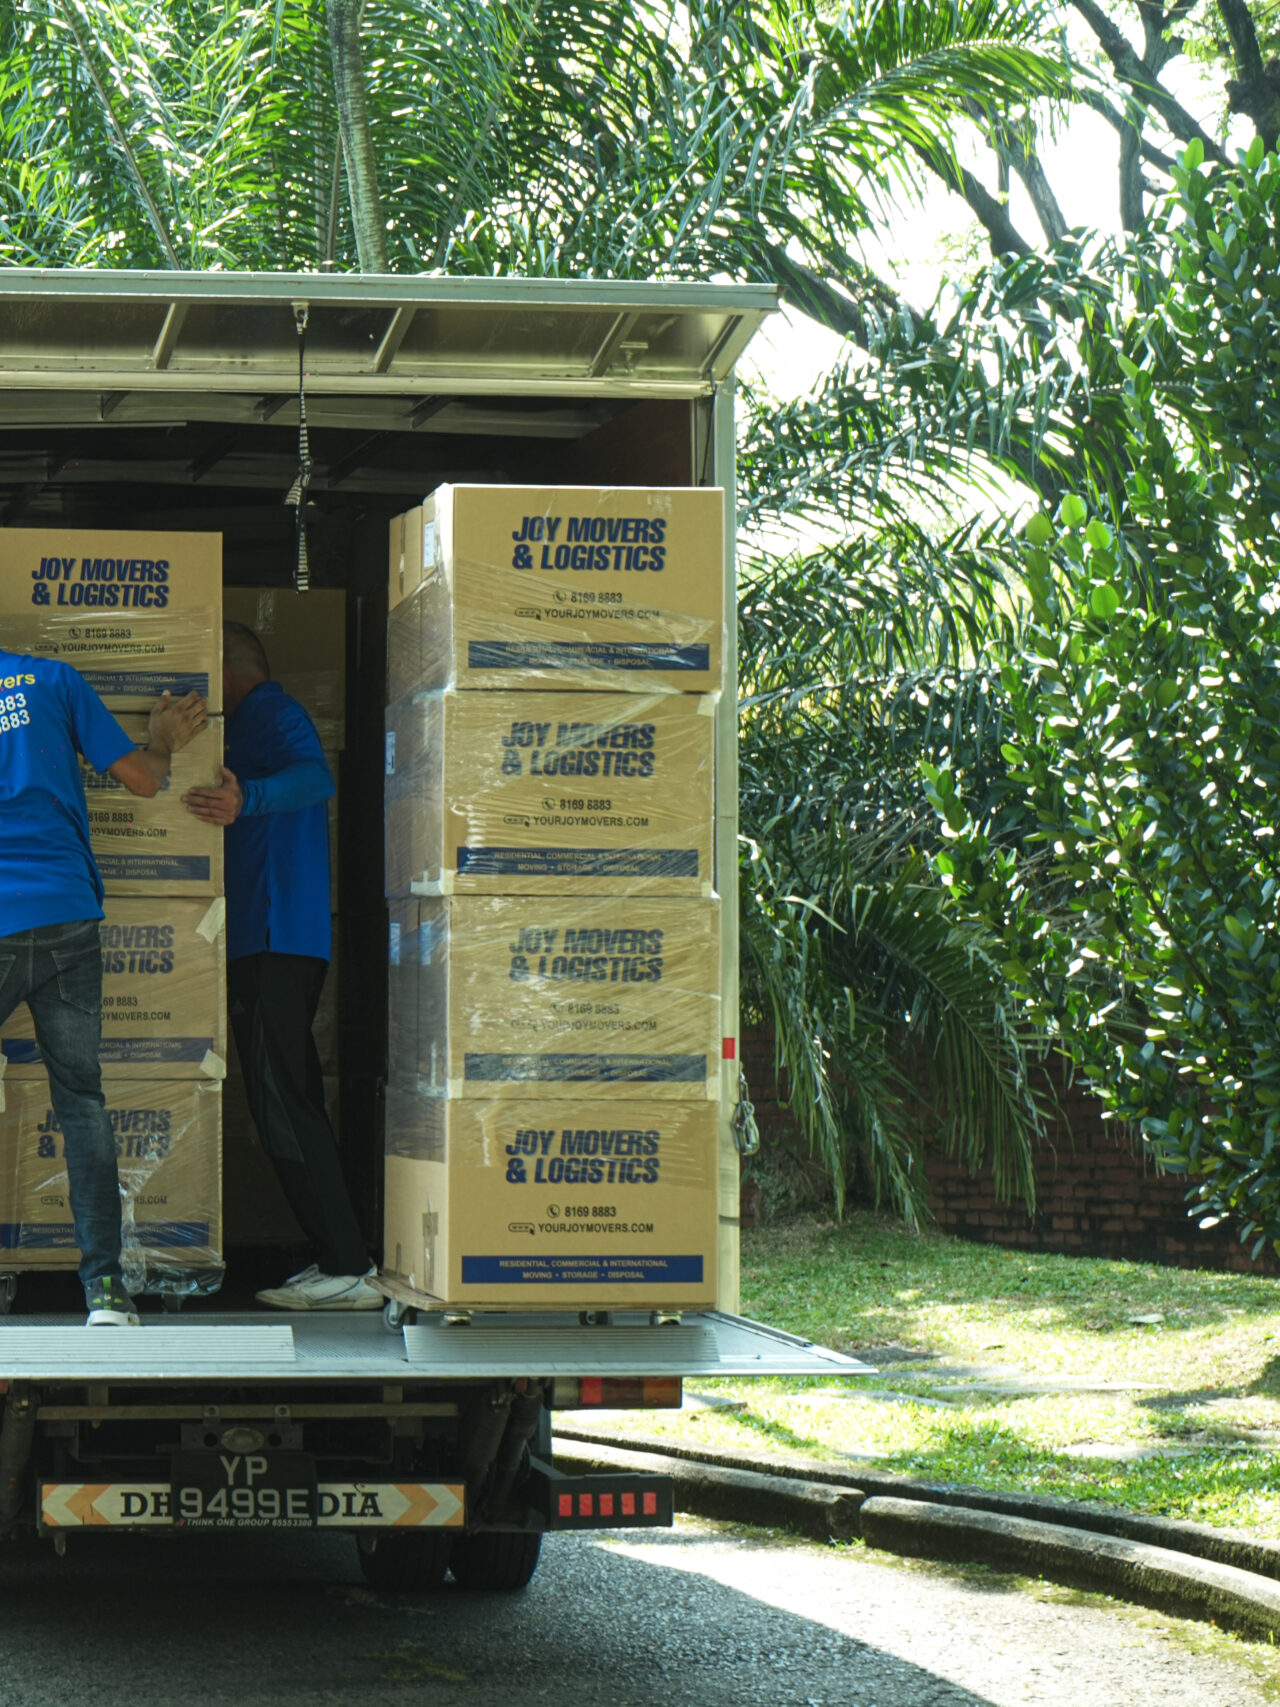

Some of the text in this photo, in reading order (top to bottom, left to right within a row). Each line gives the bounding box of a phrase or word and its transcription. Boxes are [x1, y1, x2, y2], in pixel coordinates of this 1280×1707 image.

[512, 516, 667, 543] JOY MOVERS
[32, 557, 169, 582] JOY MOVERS
[512, 544, 667, 571] & LOGISTICS
[32, 582, 169, 608] & LOGISTICS
[570, 592, 623, 603] 8169 8883
[501, 721, 656, 749] JOY MOVERS
[501, 749, 656, 777] & LOGISTICS
[559, 799, 612, 811] 8169 8883
[88, 812, 134, 823] 8169 8883
[534, 816, 649, 827] YOURJOYMOVERS.COM
[90, 827, 167, 838] JOYMOVERS.COM
[518, 863, 548, 871] MOVING
[509, 928, 664, 955] JOY MOVERS
[102, 951, 175, 975] ISTICS
[509, 956, 664, 983] & LOGISTICS
[101, 1011, 171, 1021] OYMOVERS.COM
[38, 1109, 172, 1133] JO OVERS
[38, 1135, 56, 1159] &
[505, 1129, 661, 1156] JOY MOVERS
[505, 1157, 660, 1184] & LOGISTICS
[564, 1206, 617, 1218] 8169 8883
[538, 1223, 654, 1233] YOURJOYMOVERS.COM
[499, 1259, 550, 1269] RESIDENTIAL,
[551, 1259, 602, 1268] COMMERCIAL
[609, 1259, 668, 1268] INTERNATIONAL
[522, 1271, 646, 1279] MOVING STORAGE DISPOSAL
[220, 1455, 268, 1486] YP
[120, 1491, 384, 1518] DH DIA
[179, 1487, 310, 1519] 9499E
[187, 1518, 215, 1527] THINK
[216, 1518, 236, 1527] ONE
[237, 1518, 270, 1527] GROUP
